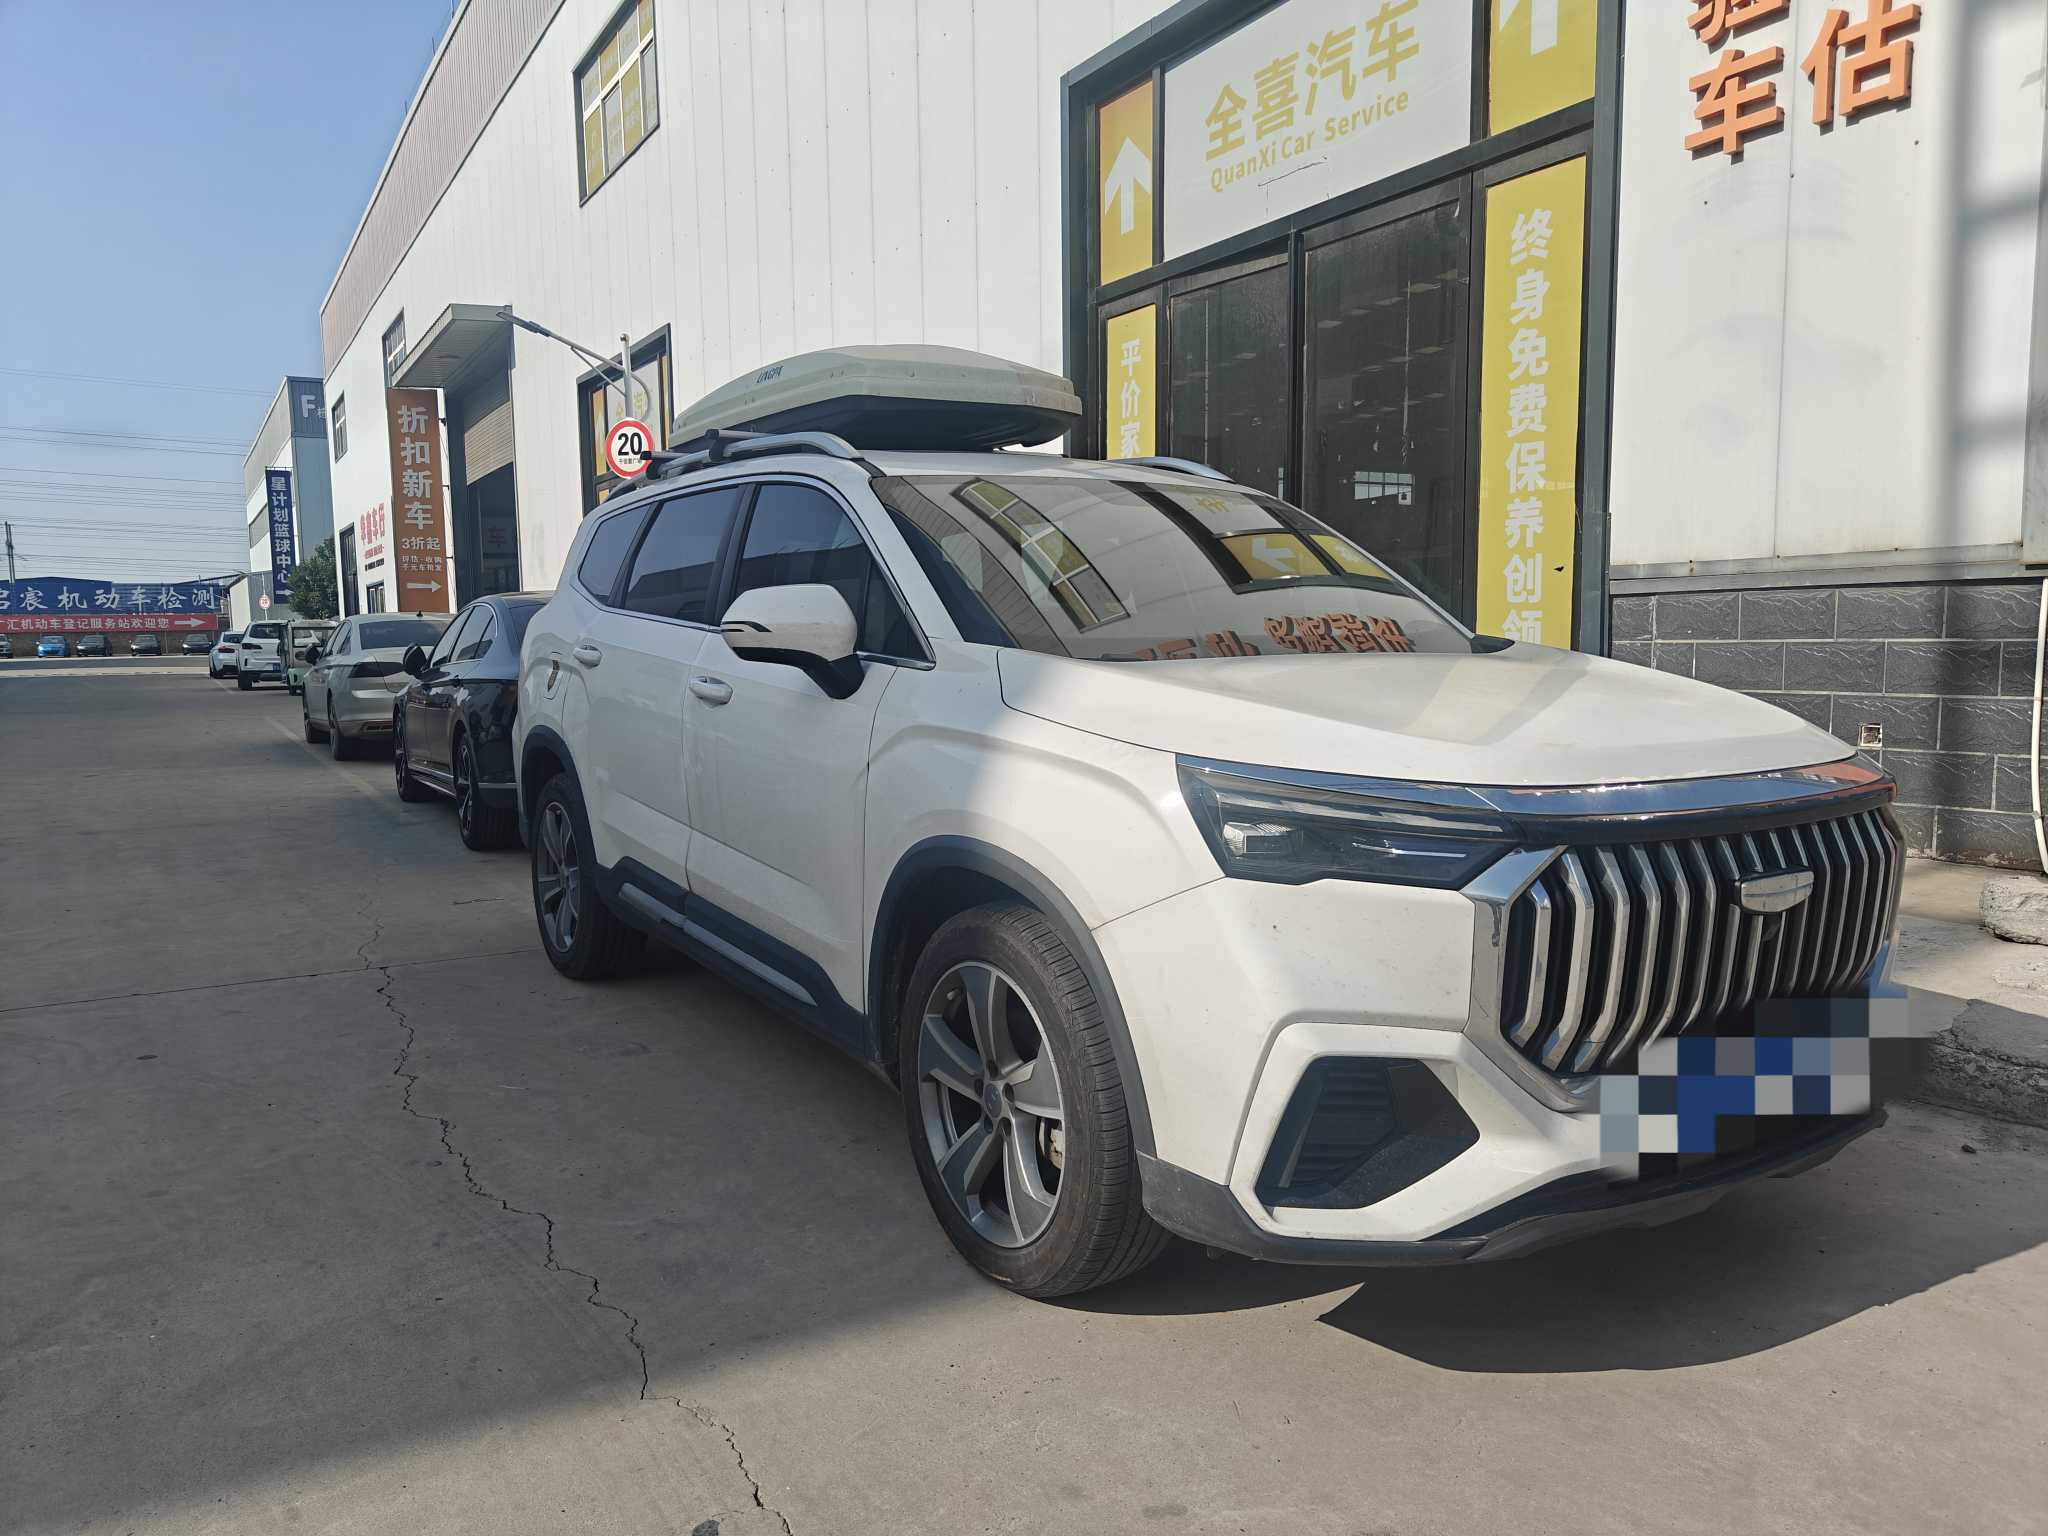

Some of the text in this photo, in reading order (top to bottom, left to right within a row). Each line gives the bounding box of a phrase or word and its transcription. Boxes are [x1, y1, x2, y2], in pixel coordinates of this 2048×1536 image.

[1205, 0, 1420, 161] 全喜汽车
[1800, 0, 1921, 125] 估
[1210, 91, 1408, 193] QuanXi Car Service
[397, 404, 434, 530] 折扣新车
[617, 432, 642, 456] 20
[271, 476, 291, 583] 星计划篮球中心
[401, 536, 440, 550] 3折起
